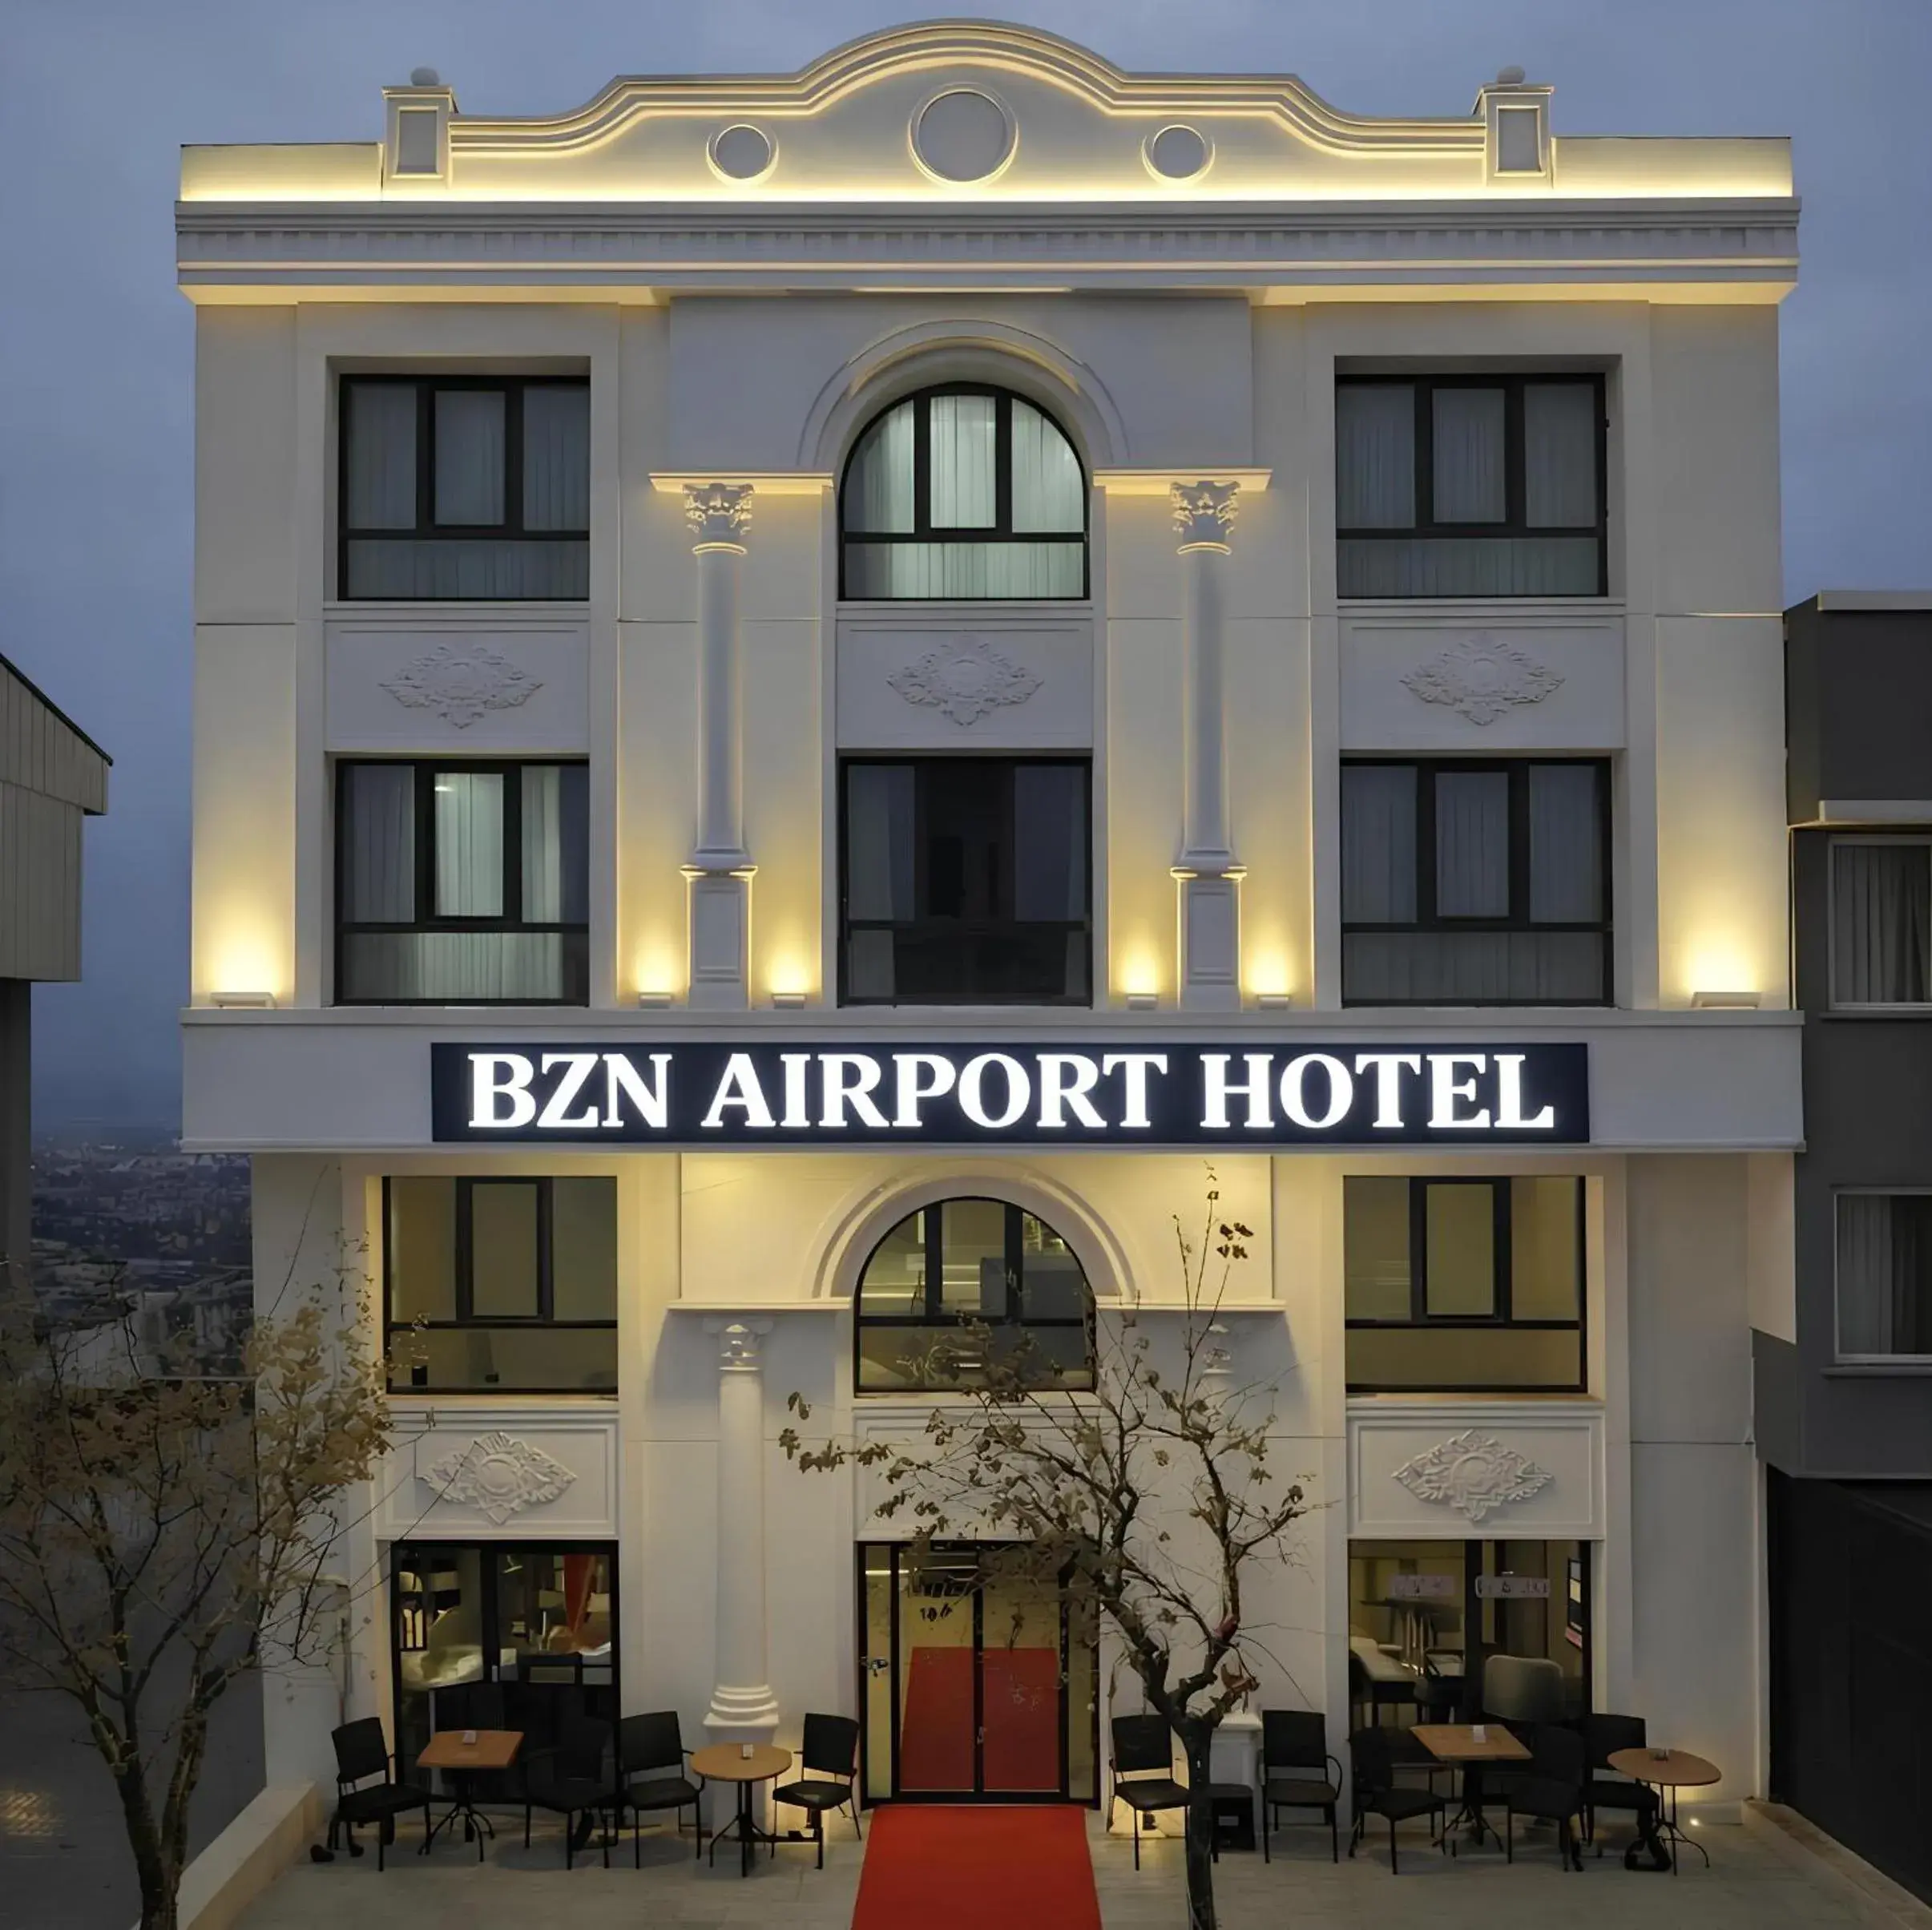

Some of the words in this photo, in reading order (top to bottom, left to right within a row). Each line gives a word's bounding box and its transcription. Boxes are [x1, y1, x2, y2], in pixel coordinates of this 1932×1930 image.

[468, 1053, 672, 1128] BZN
[700, 1053, 1168, 1128] AIRPORT
[1200, 1053, 1554, 1129] HOTEL
